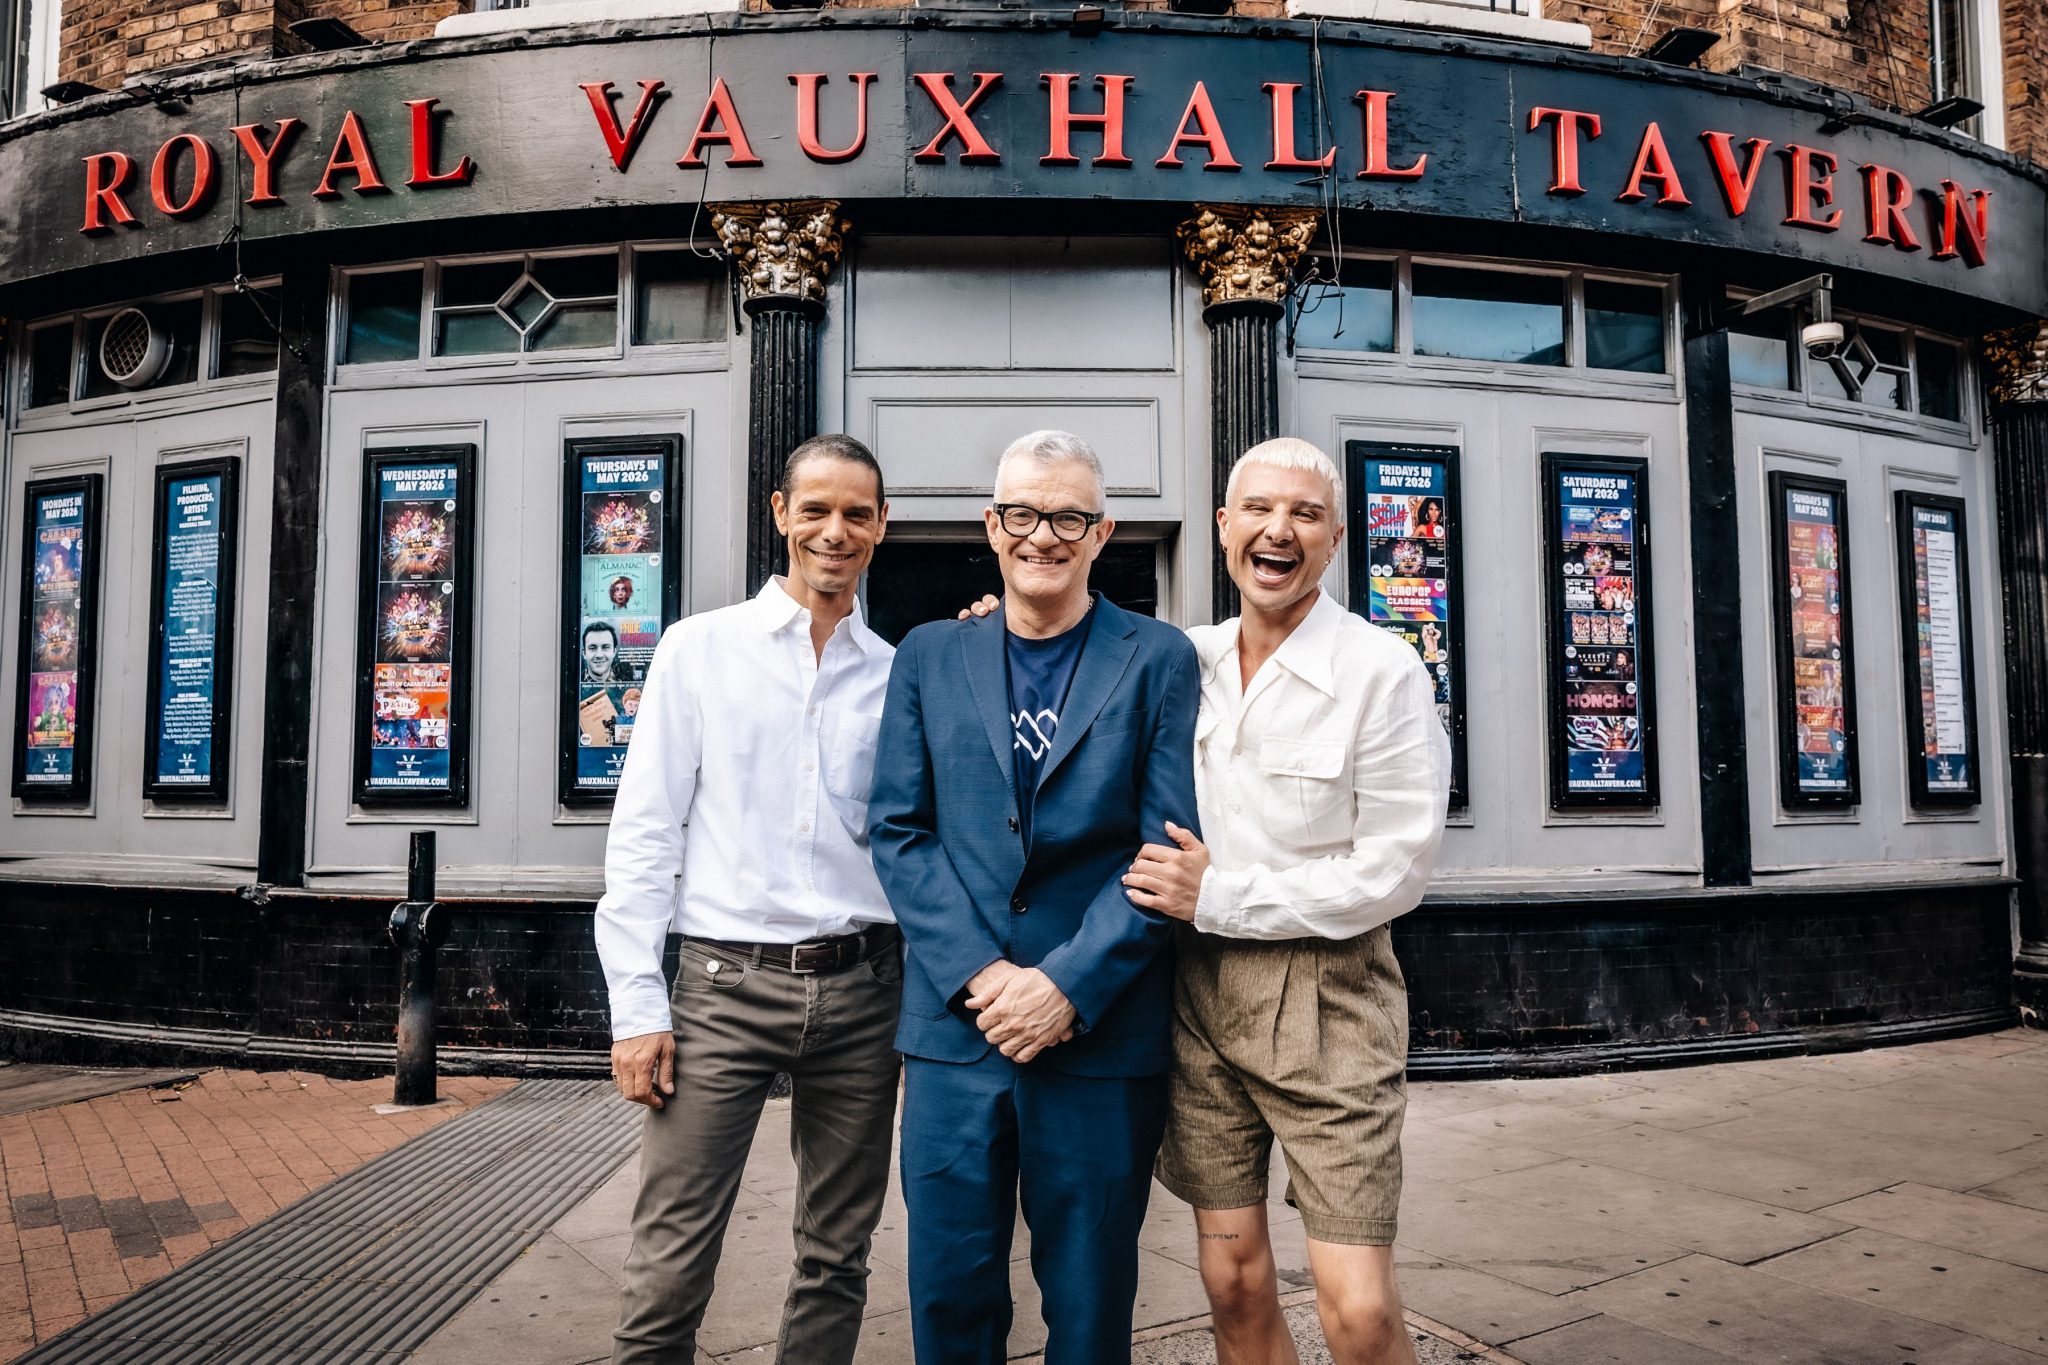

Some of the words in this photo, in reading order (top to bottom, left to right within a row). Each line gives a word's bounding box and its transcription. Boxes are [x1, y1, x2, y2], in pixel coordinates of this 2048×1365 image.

[78, 97, 472, 233] ROYAL
[578, 72, 1428, 183] VAUXHALL
[1527, 105, 1993, 268] TAVERN
[587, 460, 646, 473] THURSDAYS
[647, 459, 659, 470] IN
[1379, 464, 1420, 477] FRIDAYS
[1421, 466, 1432, 478] IN
[382, 469, 446, 482] WEDNESDAYS
[448, 468, 458, 480] IN
[596, 472, 620, 484] MAY
[621, 471, 649, 483] 2026
[395, 481, 418, 492] MAY
[419, 480, 445, 491] 2026
[1380, 476, 1402, 487] MAY
[1404, 477, 1431, 488] 2026
[1562, 475, 1616, 489] SATURDAYS
[1617, 478, 1628, 490] IN
[182, 483, 210, 495] FILMING,
[1572, 487, 1595, 499] MAY
[1594, 488, 1620, 500] 2026
[42, 497, 74, 511] MONDAYS
[177, 493, 215, 506] PRODUCERS,
[1792, 493, 1822, 507] SUNDAYS
[45, 509, 61, 519] MAY
[61, 507, 78, 518] 2026
[183, 503, 208, 515] ARTISTS
[1795, 503, 1810, 514] MAY
[1810, 506, 1829, 517] 2026
[1918, 511, 1931, 523] MAY
[1931, 514, 1948, 525] 2026
[601, 562, 642, 570] ALMANAC
[1386, 585, 1432, 597] EUROPOP
[1386, 597, 1432, 606] CLASSICS
[1567, 693, 1637, 709] HONCHO
[370, 777, 448, 786] VAUXHALLTAVERN.COM
[578, 777, 620, 785] VAUXHALLT
[1568, 780, 1642, 788] VAUXHALLTAVERN.COM
